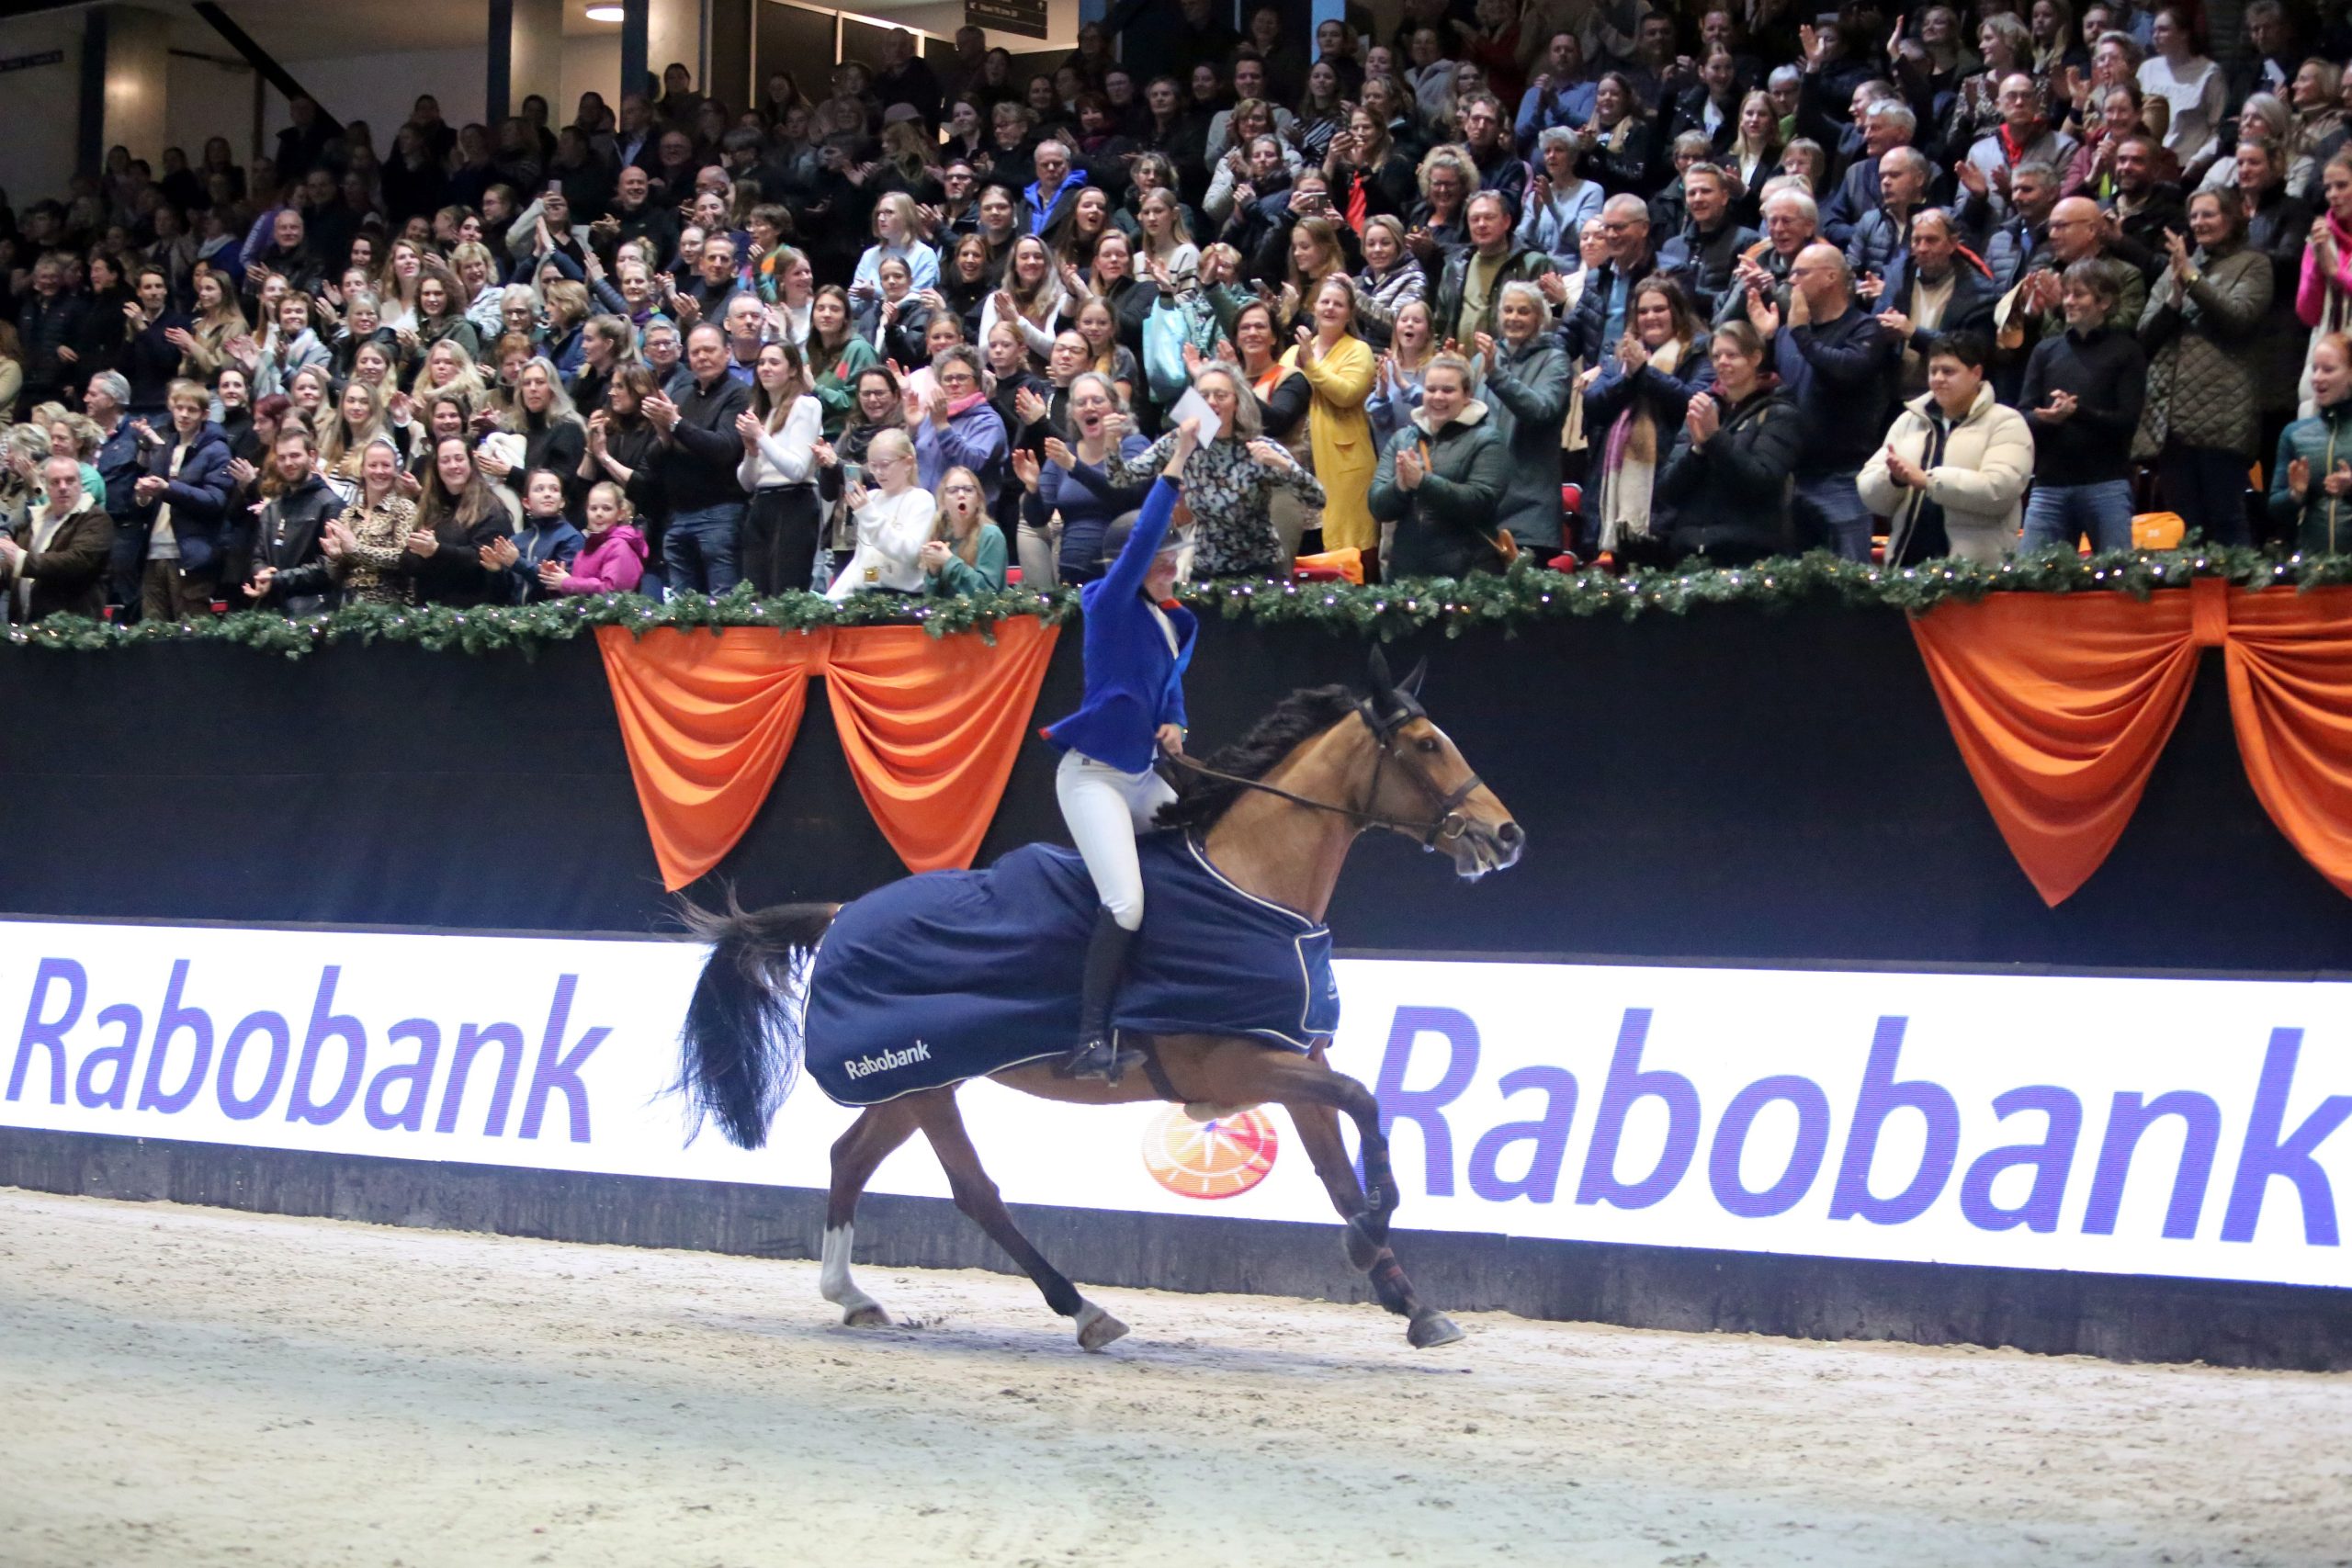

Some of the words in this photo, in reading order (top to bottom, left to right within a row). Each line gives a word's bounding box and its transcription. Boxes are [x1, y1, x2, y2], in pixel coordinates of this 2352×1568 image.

[5, 957, 614, 1144] Rabobank
[844, 1040, 932, 1080] Rabobank
[1353, 1005, 2352, 1247] Rabobank
